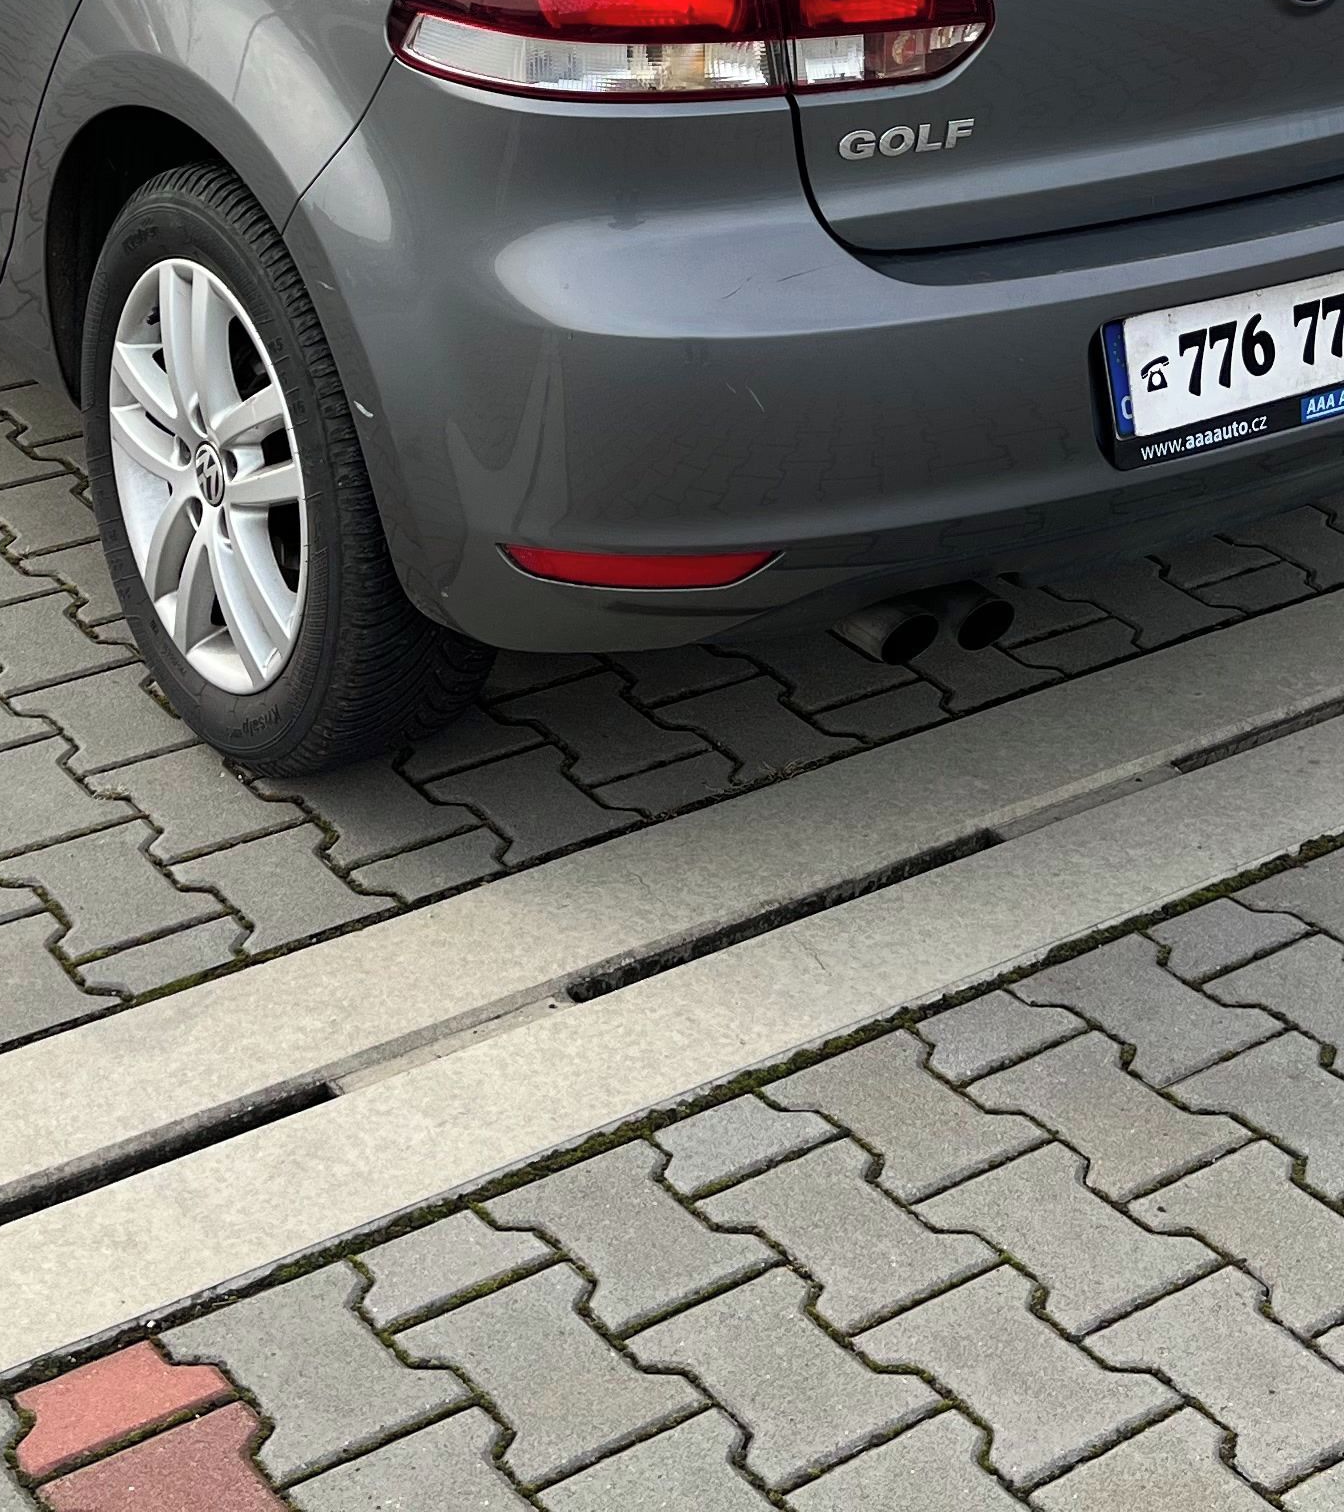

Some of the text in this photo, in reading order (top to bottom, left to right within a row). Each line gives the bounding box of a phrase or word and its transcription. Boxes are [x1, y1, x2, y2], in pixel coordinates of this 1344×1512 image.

[839, 118, 975, 161] GOLF
[1178, 313, 1276, 397] 776
[1306, 395, 1336, 415] AAA
[1141, 415, 1268, 461] www.aaaauto.cz
